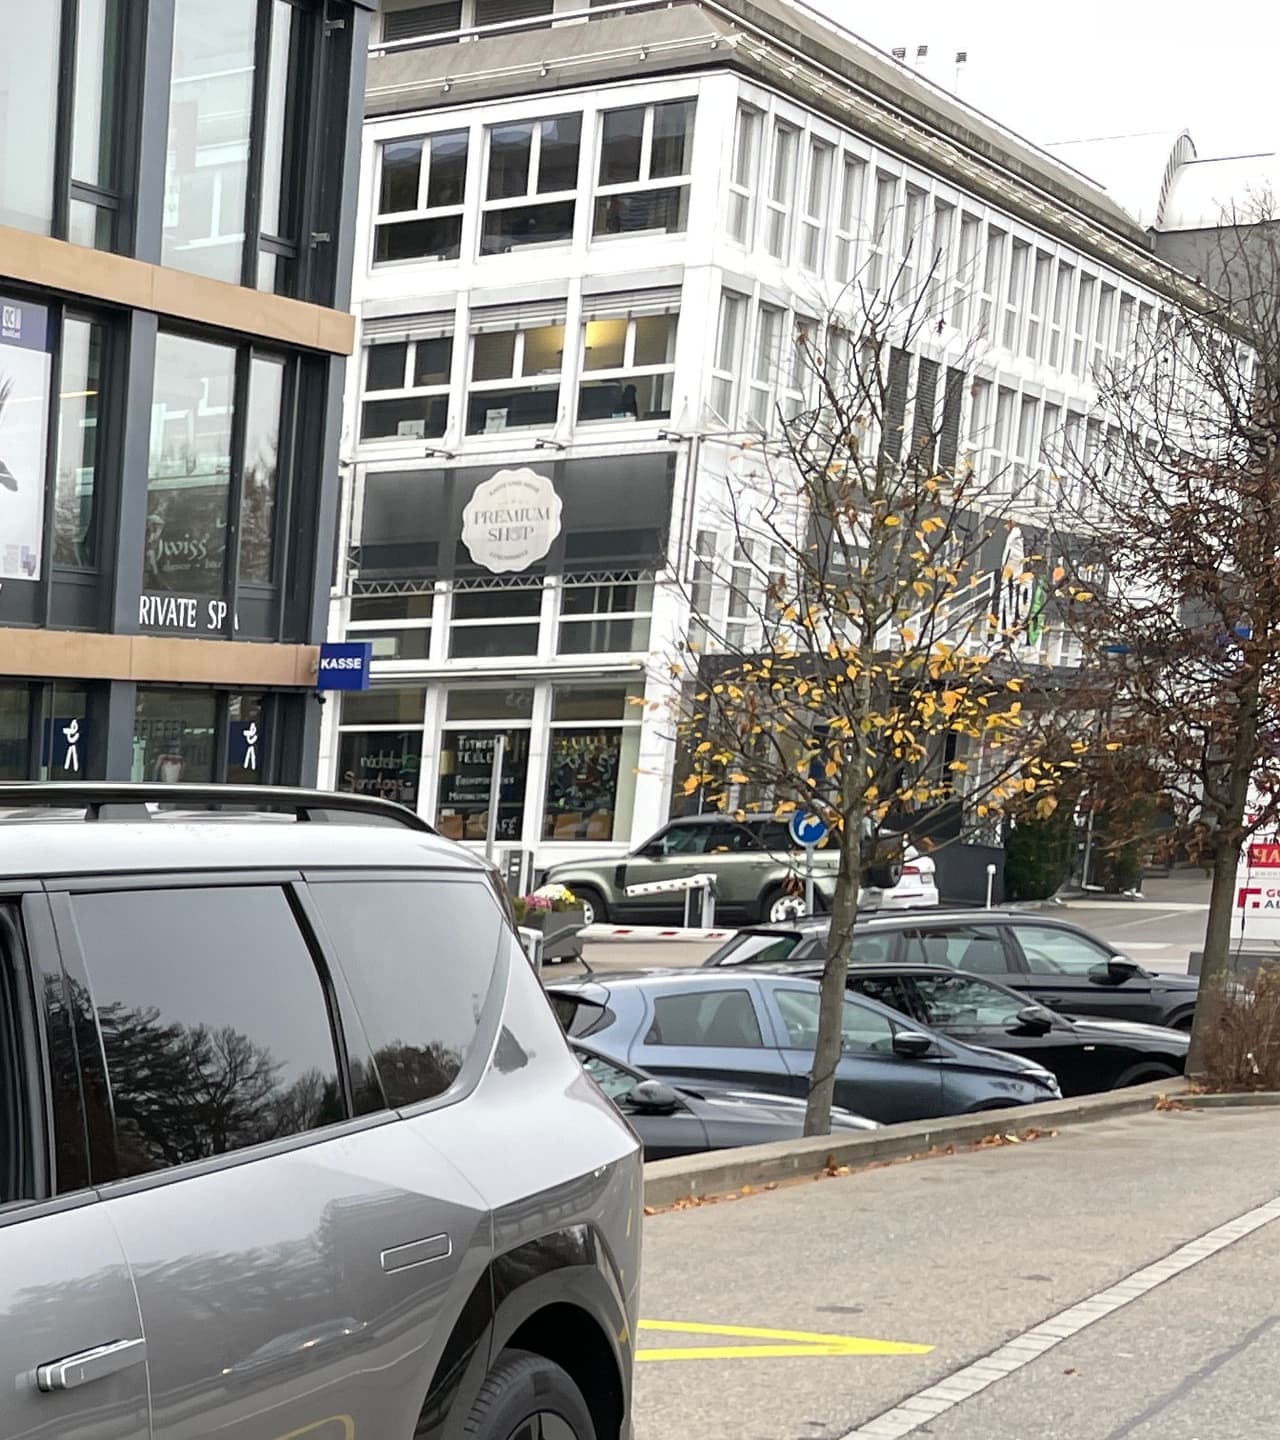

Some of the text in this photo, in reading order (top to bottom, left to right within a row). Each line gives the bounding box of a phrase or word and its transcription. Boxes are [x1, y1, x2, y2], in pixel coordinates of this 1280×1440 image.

[474, 507, 550, 525] PREMIUM
[207, 601, 239, 630] SP
[321, 658, 362, 669] KASSE
